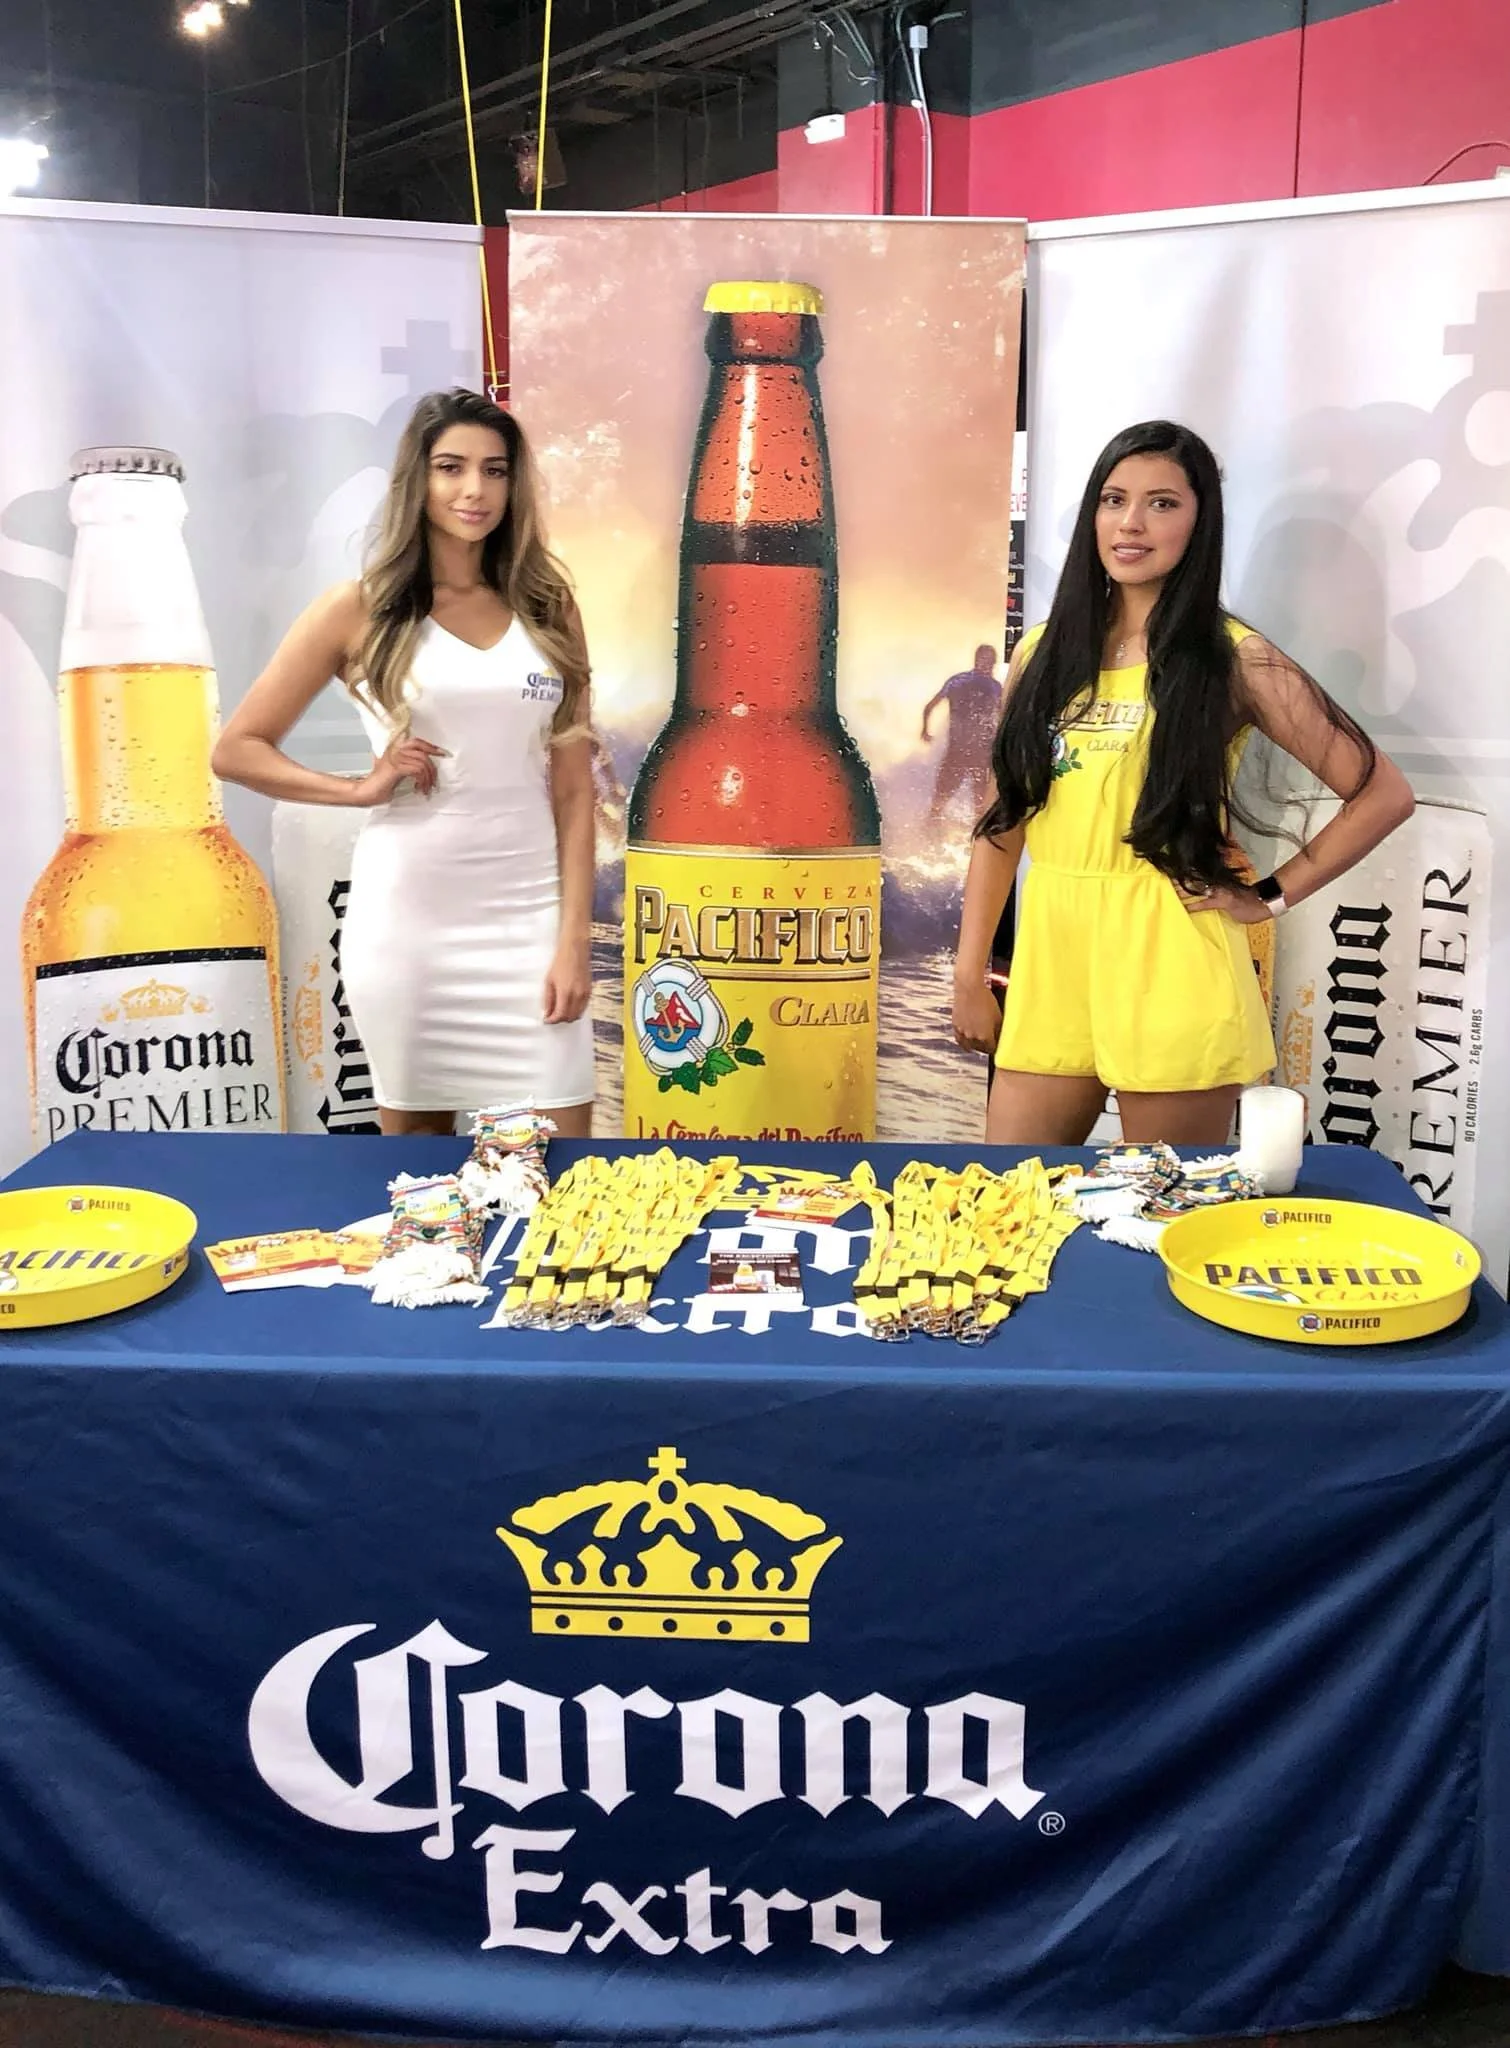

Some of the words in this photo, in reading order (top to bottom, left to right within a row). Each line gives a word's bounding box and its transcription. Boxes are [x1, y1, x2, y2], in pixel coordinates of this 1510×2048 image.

[700, 884, 873, 900] CERVEZA
[634, 885, 874, 964] PACIFICO
[769, 996, 869, 1027] CLARA
[1320, 902, 1393, 1150] orona
[1471, 1008, 1483, 1041] CARBS
[56, 1027, 255, 1099] Corona
[1409, 869, 1472, 1218] REMIER
[1469, 1044, 1483, 1064] 2.6g
[48, 1083, 275, 1144] PREMIER
[1464, 1081, 1478, 1127] CALORIES
[1464, 1130, 1476, 1142] 90
[1283, 1211, 1332, 1224] PACIFICO
[1204, 1263, 1422, 1286] PACIFICO
[1324, 1316, 1381, 1330] PACIFICO
[247, 1617, 1047, 1861] Corona
[473, 1823, 893, 1957] Extra
